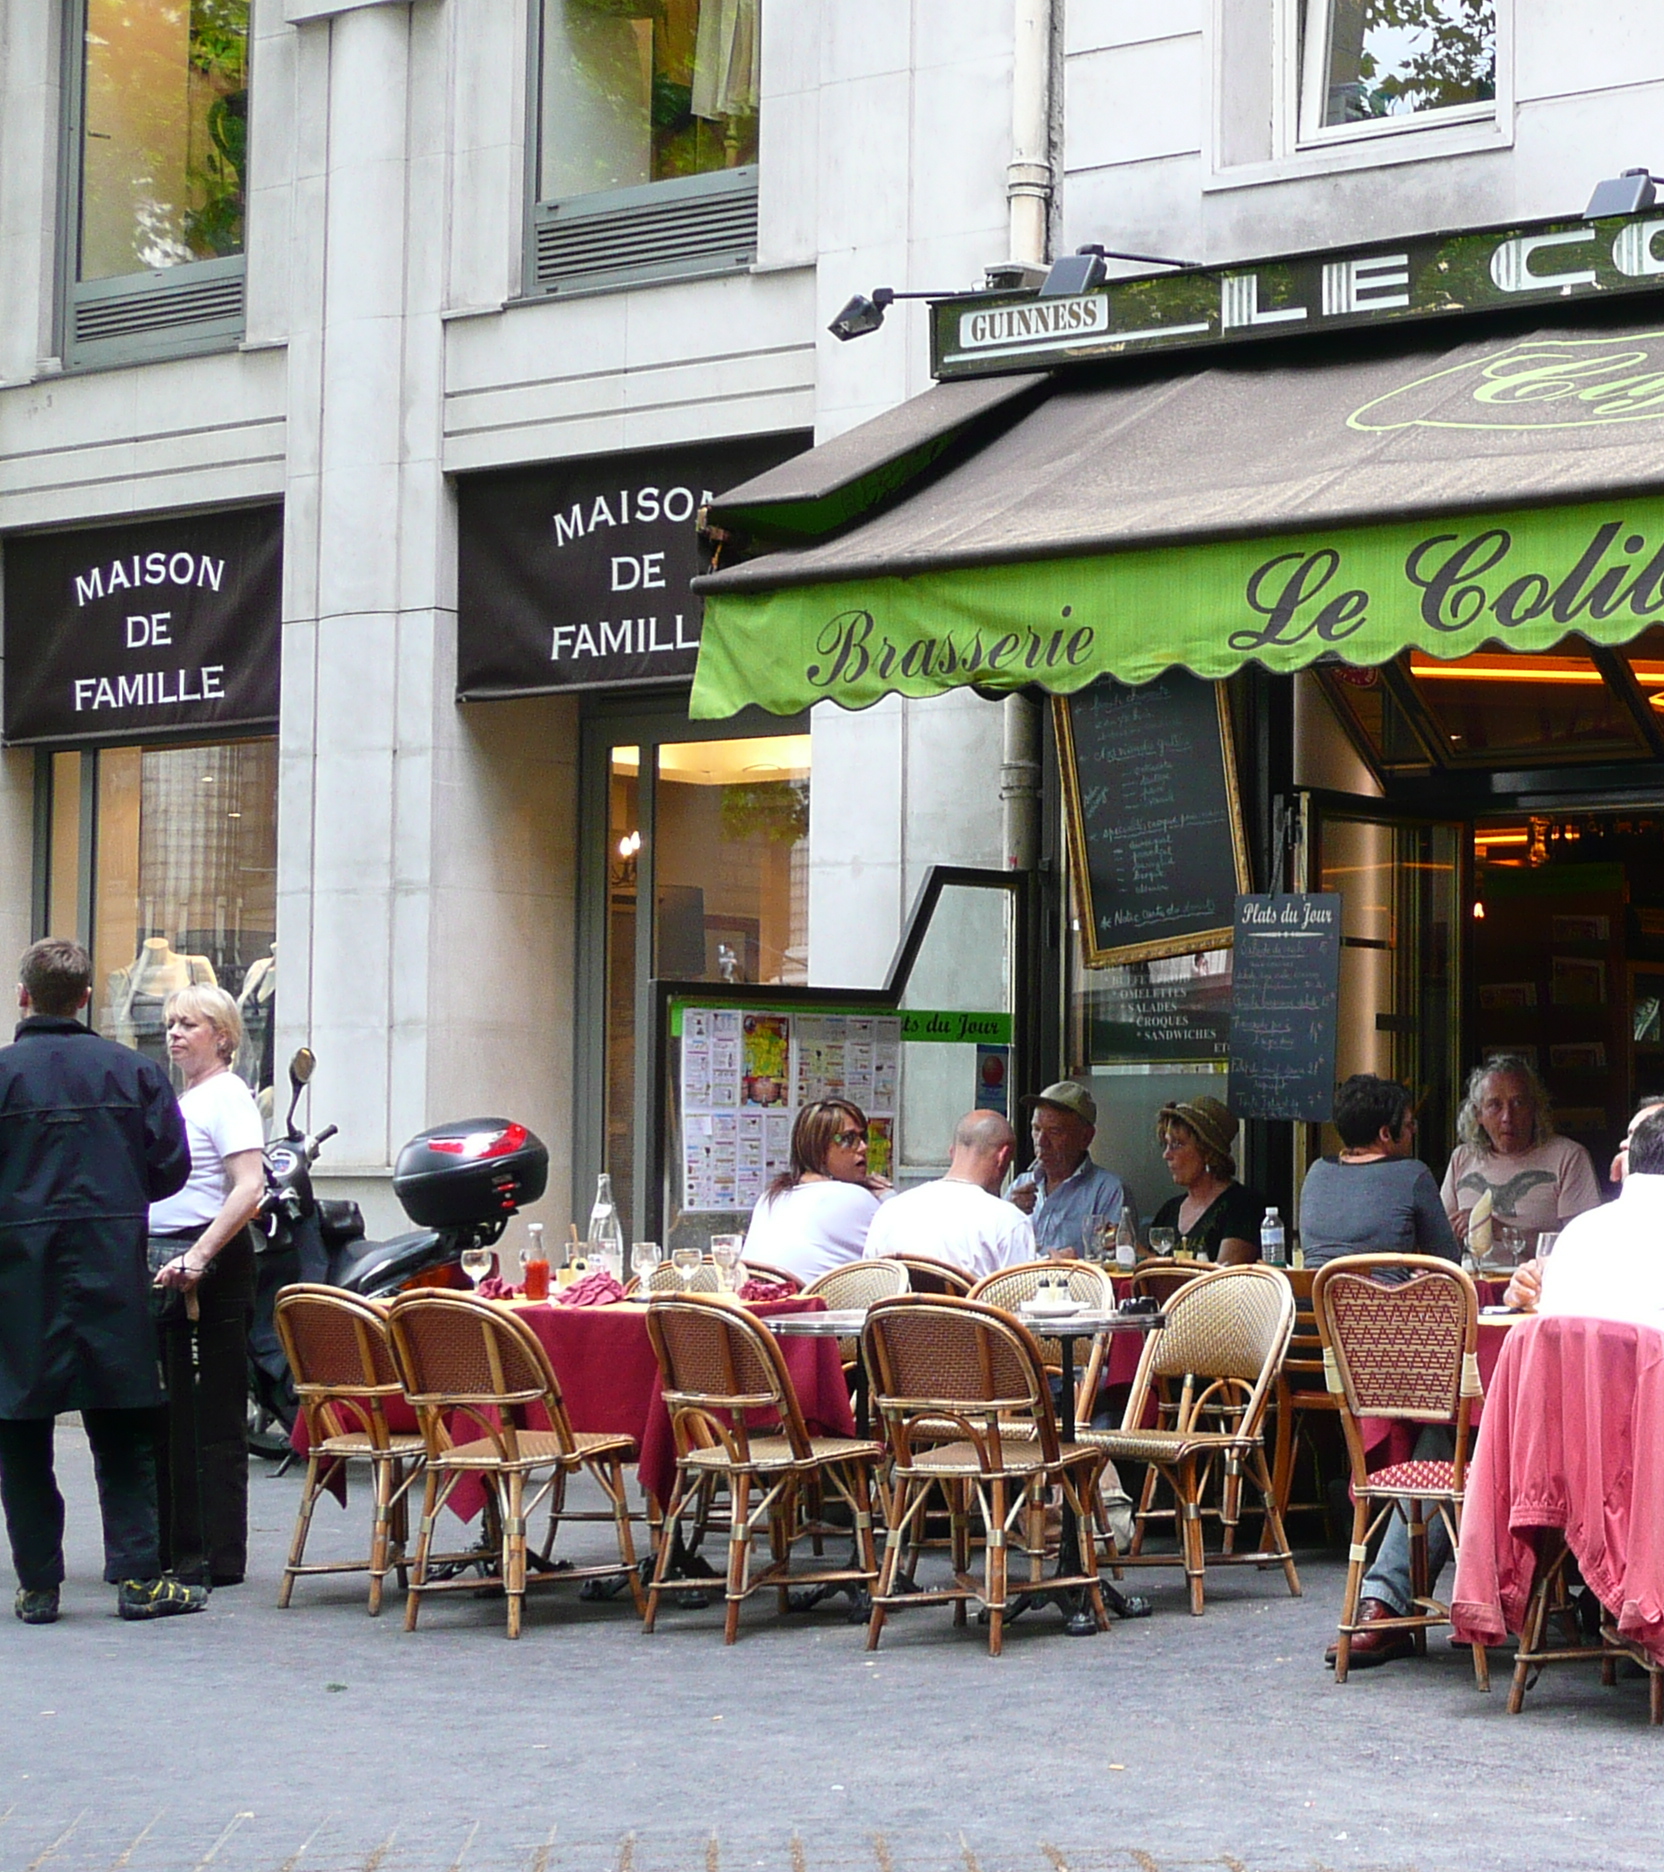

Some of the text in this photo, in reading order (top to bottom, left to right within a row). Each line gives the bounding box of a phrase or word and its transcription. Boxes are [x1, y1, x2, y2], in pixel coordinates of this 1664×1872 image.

[1221, 253, 1410, 328] LE
[969, 298, 1099, 343] GUINNESS
[74, 550, 227, 608] MAISON
[610, 551, 667, 592] DE
[1227, 547, 1370, 651] Le
[125, 610, 173, 650] DE
[550, 614, 701, 660] FAMILL
[806, 604, 1095, 688] Brasserie
[73, 664, 226, 712] FAMILLE
[1241, 902, 1277, 924] Plats
[1280, 902, 1299, 924] du
[1300, 902, 1333, 930] Jour
[1120, 987, 1187, 1000] OMELETTES
[1127, 1001, 1178, 1013] SALADES
[925, 1012, 952, 1034] du
[957, 1013, 1000, 1040] Jour
[1136, 1015, 1189, 1028] CROQUES
[1144, 1028, 1217, 1041] SANDWICHES
[1213, 1042, 1230, 1053] ET
